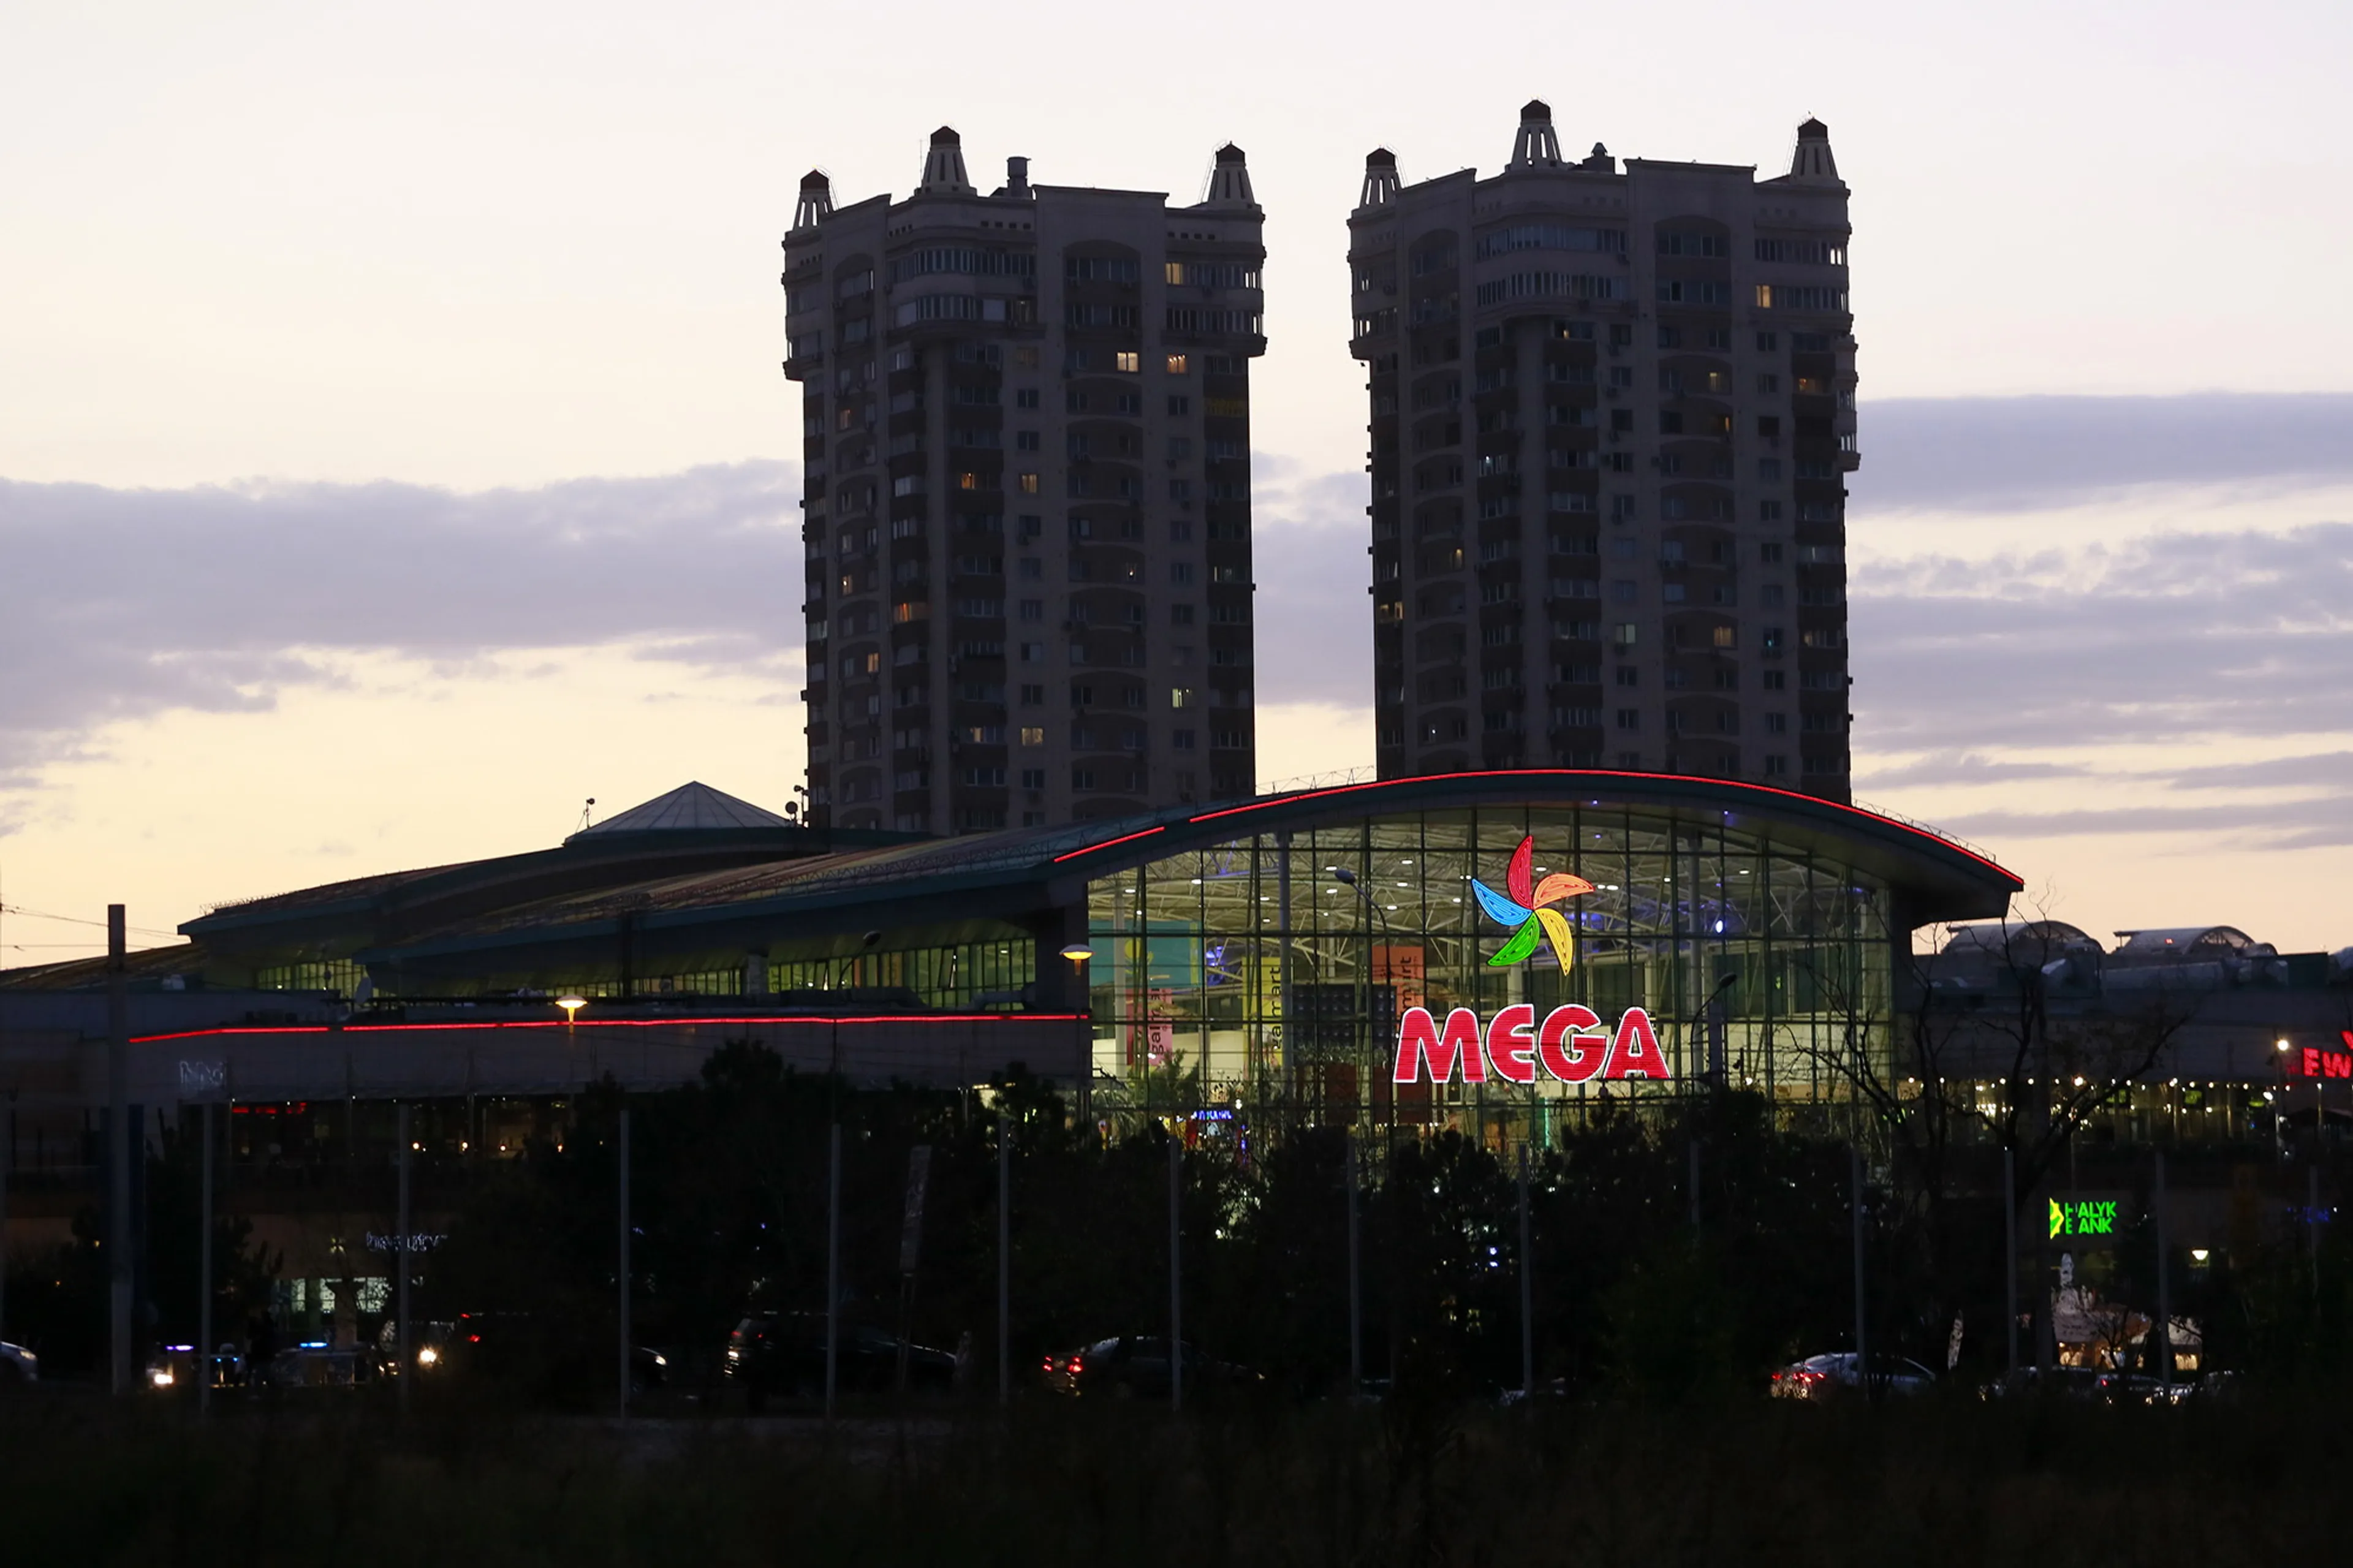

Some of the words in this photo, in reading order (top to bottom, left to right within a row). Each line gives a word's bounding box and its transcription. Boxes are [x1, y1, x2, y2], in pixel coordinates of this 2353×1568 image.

[1270, 966, 1282, 1050] gamart
[1393, 1004, 1671, 1084] MEGA
[2293, 1047, 2352, 1078] EW
